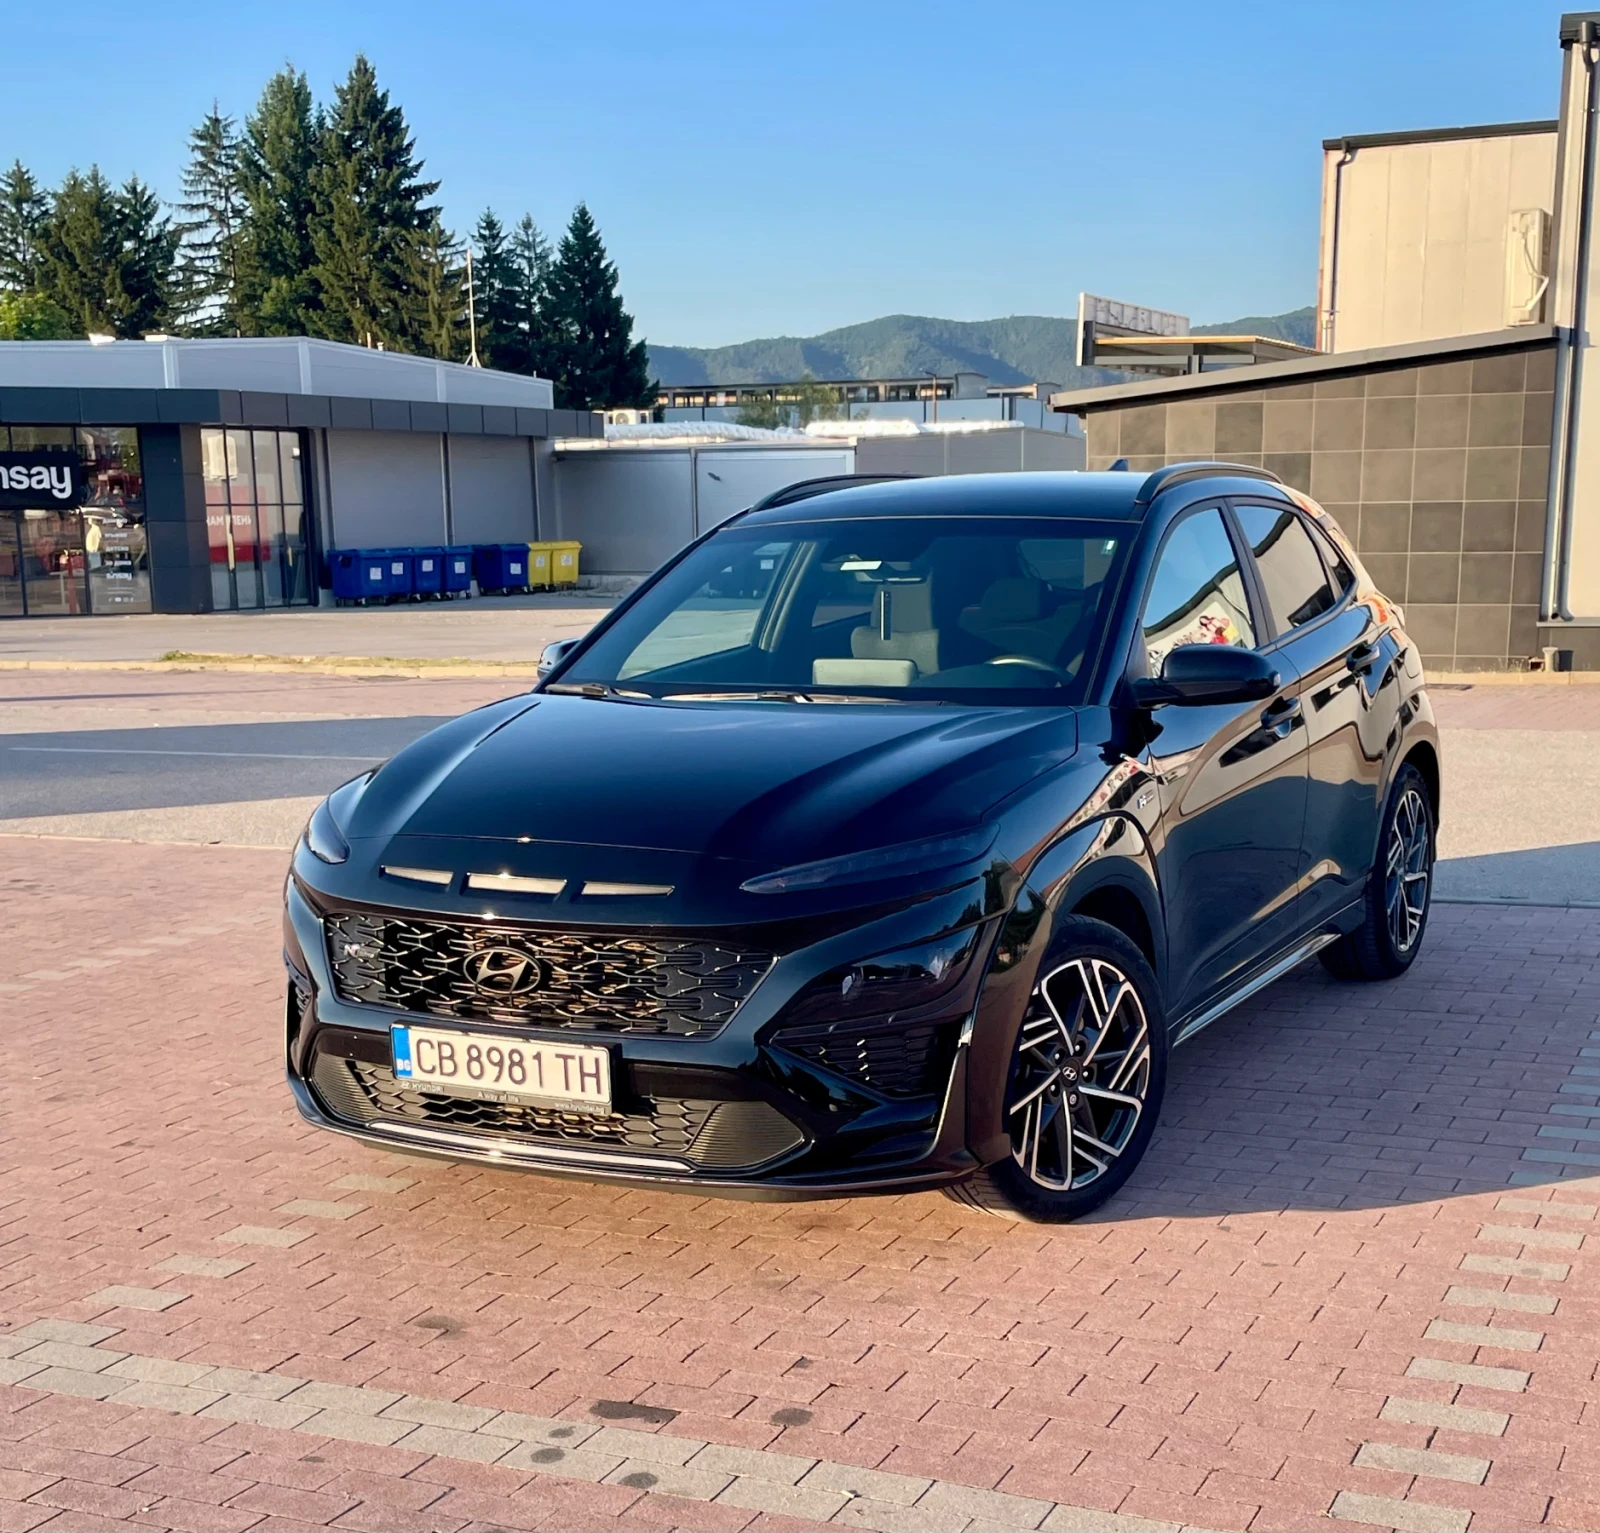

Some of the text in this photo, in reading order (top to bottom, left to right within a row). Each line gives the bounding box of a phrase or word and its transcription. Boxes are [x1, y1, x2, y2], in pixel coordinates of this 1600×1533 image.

[396, 1058, 412, 1072] BG
[416, 1038, 602, 1095] CB 8981 TH
[411, 1082, 444, 1093] HYUNDAI
